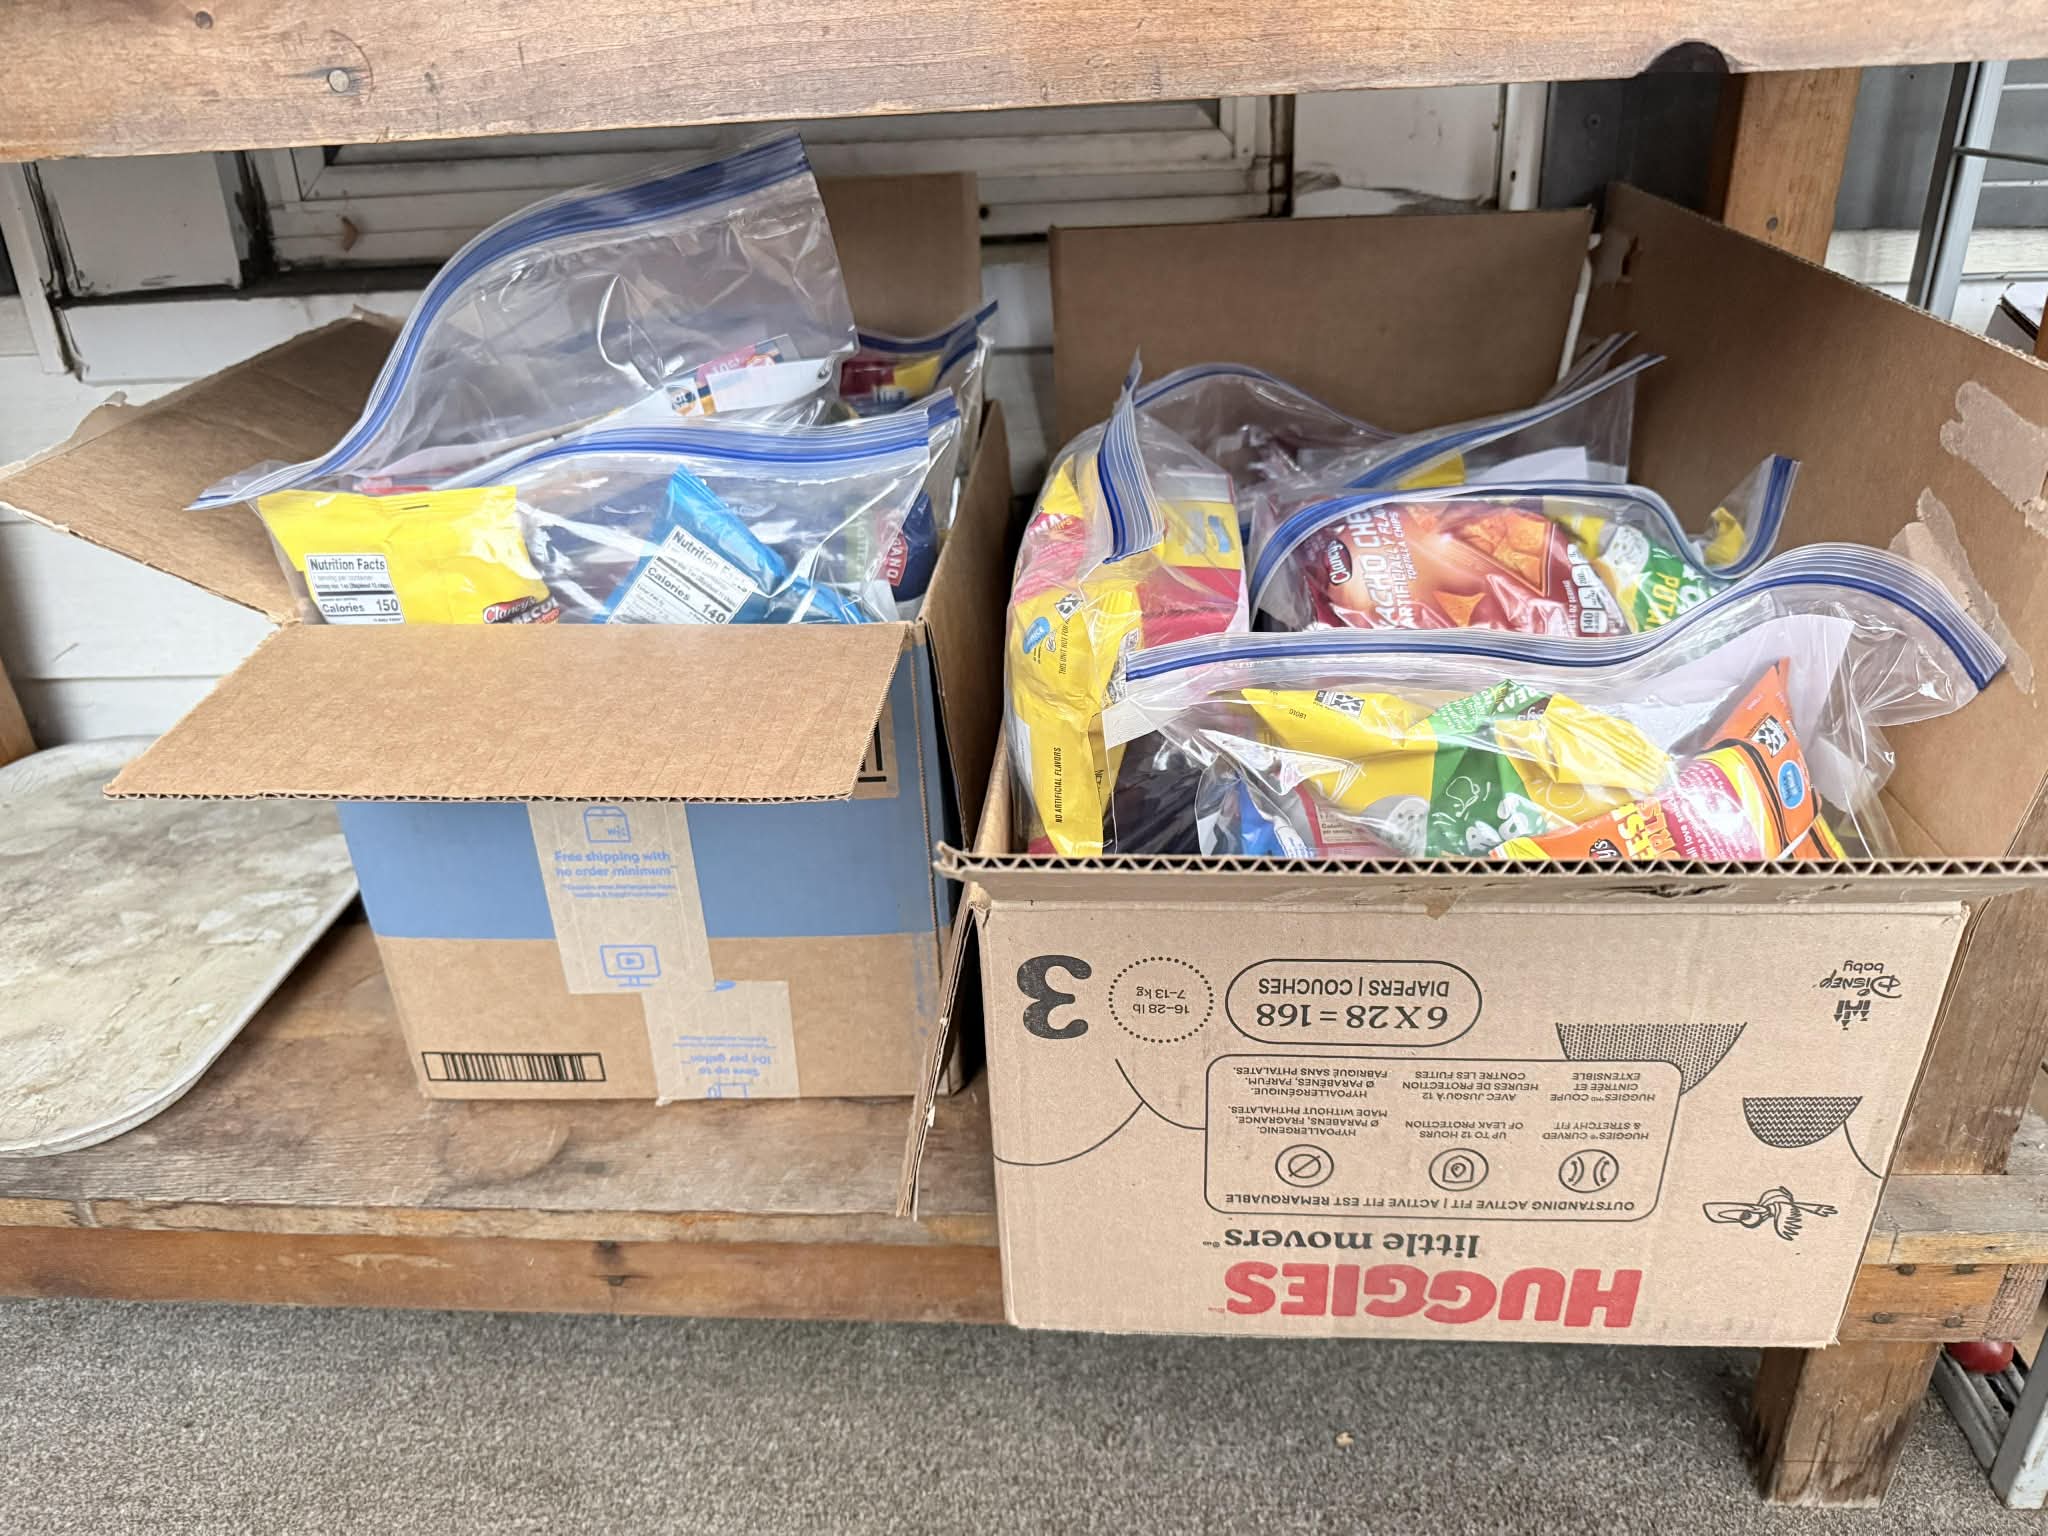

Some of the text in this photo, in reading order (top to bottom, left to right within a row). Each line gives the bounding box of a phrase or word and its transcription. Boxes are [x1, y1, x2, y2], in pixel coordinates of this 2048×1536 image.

[1346, 511, 1380, 547] CHE
[671, 530, 719, 570] Nutrition
[1390, 511, 1417, 579] TORTILLA CHIPS
[309, 558, 386, 571] Nutrition Facts
[1384, 539, 1416, 628] ARTIFICIALLY
[647, 567, 690, 601] Calories
[701, 603, 727, 624] 140
[321, 598, 399, 613] Calories 150
[1061, 624, 1069, 636] FOR
[1060, 636, 1068, 648] NOT
[1059, 662, 1067, 674] THIS
[1053, 746, 1063, 823] NO ARTIFICIAL FLAVORS
[1680, 822, 1693, 848] love
[554, 850, 671, 864] Free shipping with
[555, 867, 573, 877] no
[575, 866, 608, 877] order
[1843, 960, 1884, 974] baby
[1259, 978, 1352, 995] COUCHES
[1369, 980, 1449, 997] DIAPERS
[1820, 970, 1902, 999] Disney
[1017, 955, 1092, 1039] 3
[1136, 986, 1151, 999] kg
[1133, 1004, 1144, 1014] lb
[730, 1054, 748, 1063] per
[698, 1066, 760, 1076] Save up to
[1233, 1067, 1387, 1078] FABRIQUÉ SANS PHTALATES.
[1415, 1071, 1525, 1080] CONTRE LES FUITES
[1403, 1082, 1474, 1090] PROTECTION
[1591, 1084, 1638, 1094] CINTRÉE
[1486, 1093, 1516, 1101] AVEC
[1228, 1106, 1387, 1118] MADE WITHOUT PHTHALATES.
[1236, 1116, 1304, 1124] FRAGRANCE.
[1307, 1116, 1367, 1126] PARABENS,
[1478, 1121, 1506, 1129] LEAK
[1256, 1126, 1356, 1136] HYPOALLERGENIC.
[1474, 1131, 1489, 1139] TO
[1542, 1132, 1588, 1140] CURVED
[1226, 1194, 1329, 1206] REMARQUABLE
[1333, 1197, 1359, 1206] EST
[1363, 1198, 1384, 1207] FIT
[1389, 1198, 1439, 1208] ACTIVE
[1451, 1200, 1472, 1208] FIT
[1476, 1200, 1528, 1210] ACTIVE
[1532, 1201, 1634, 1210] OUTSTANDING
[1225, 1229, 1480, 1258] little movers
[1222, 1262, 1642, 1328] HUGGIES
